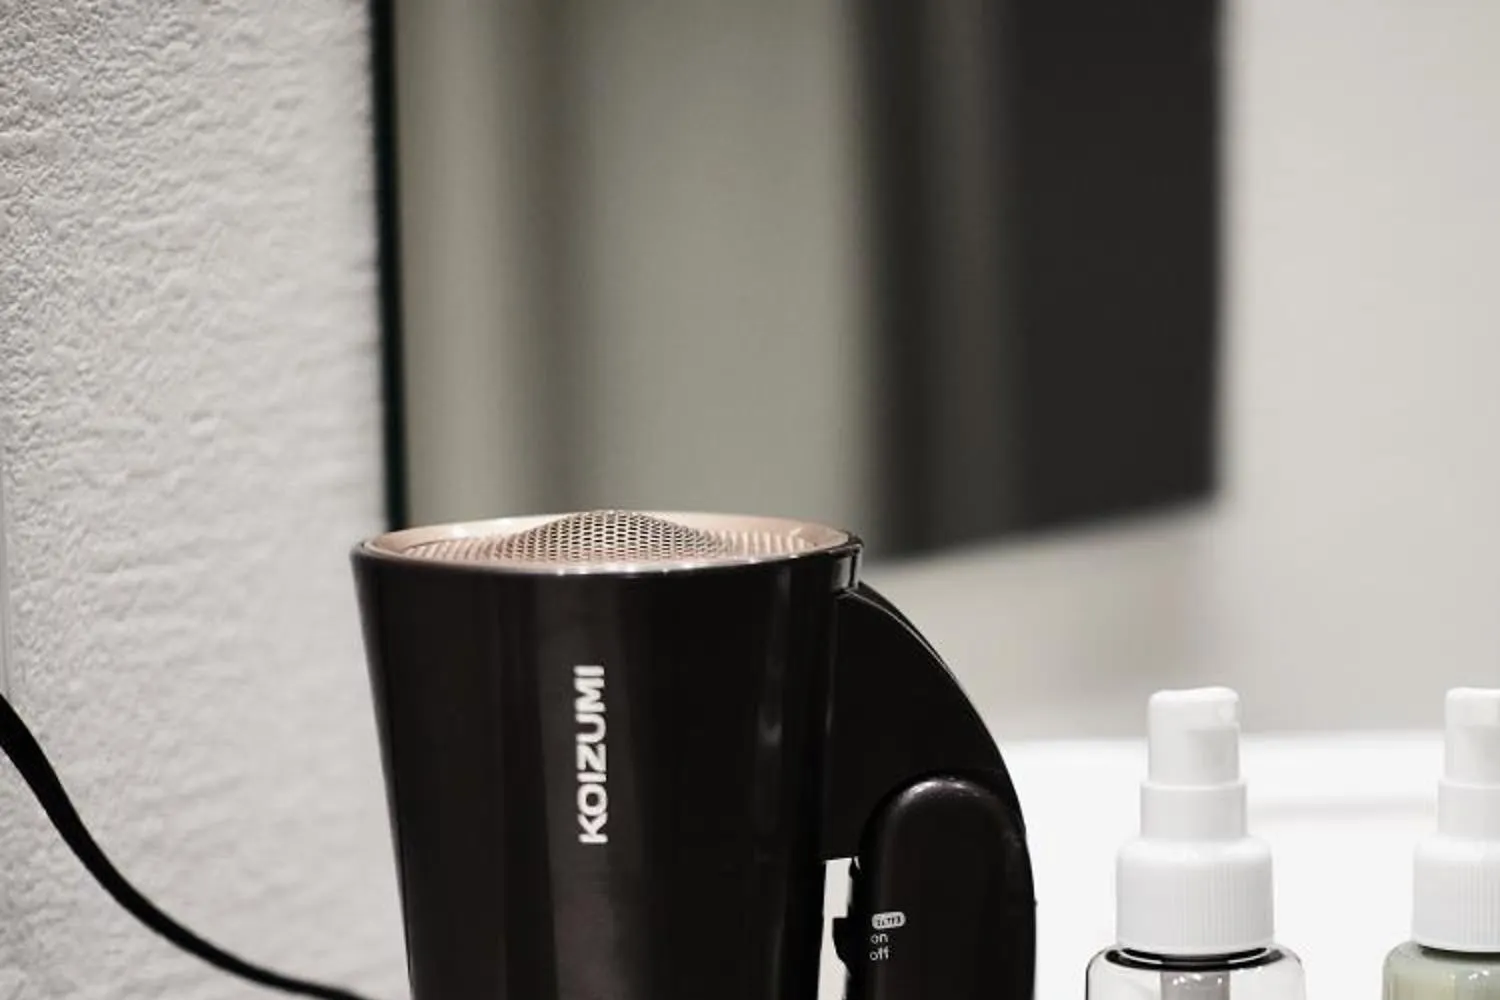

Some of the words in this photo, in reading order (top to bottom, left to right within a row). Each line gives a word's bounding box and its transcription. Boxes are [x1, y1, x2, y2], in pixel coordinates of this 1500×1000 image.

[574, 665, 608, 843] KOIZUMI
[870, 933, 889, 944] on
[869, 945, 889, 960] off
